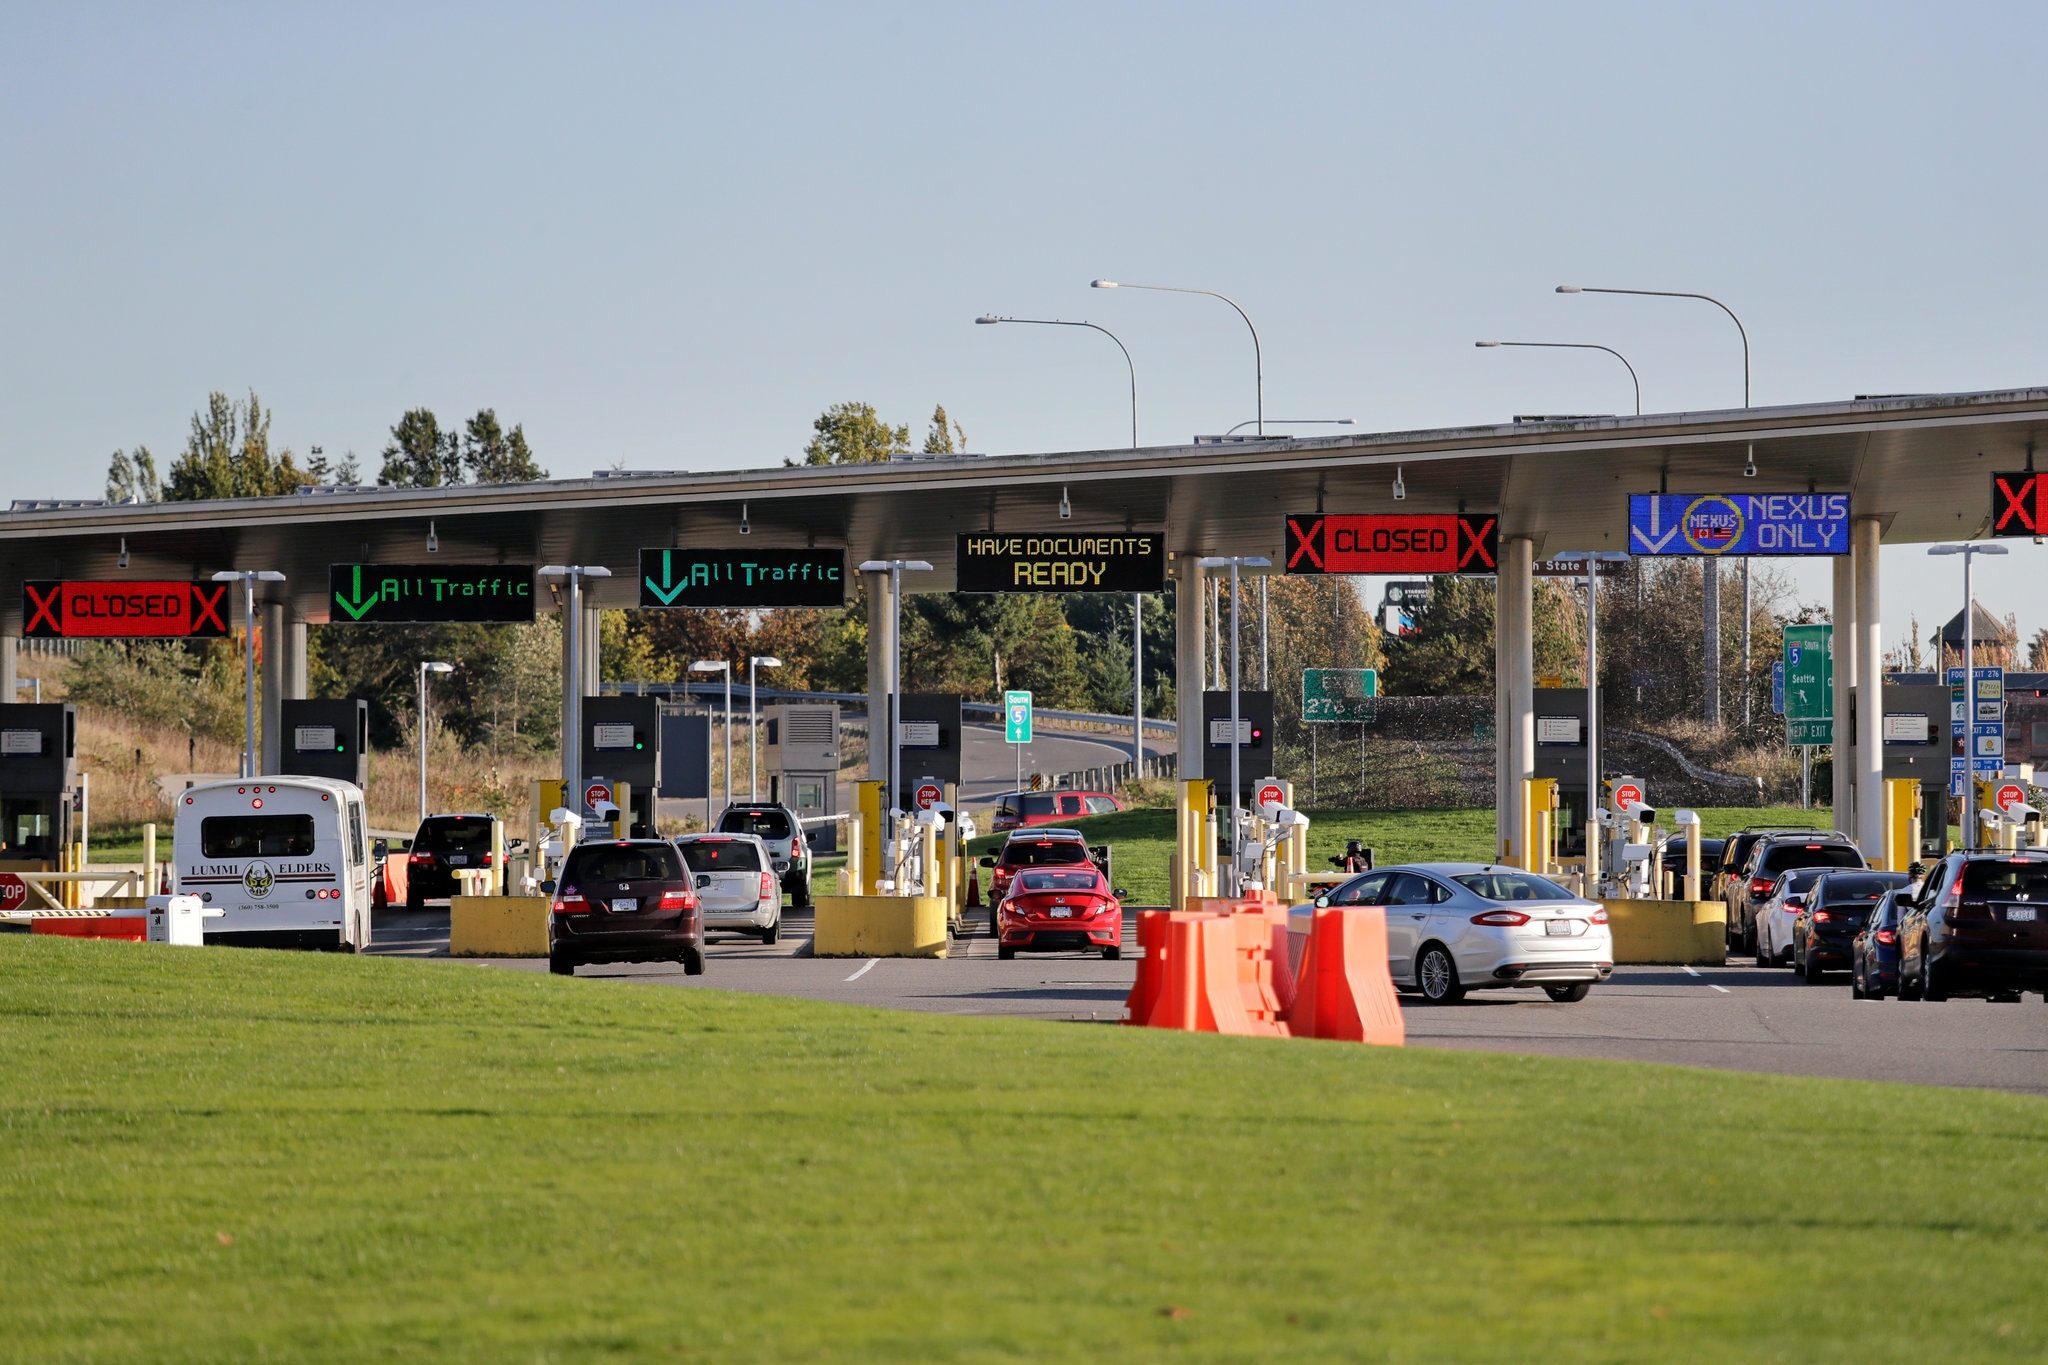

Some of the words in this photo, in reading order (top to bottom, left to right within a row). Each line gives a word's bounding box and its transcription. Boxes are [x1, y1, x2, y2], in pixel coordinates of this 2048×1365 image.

[1749, 496, 1847, 519] NEXUS
[1690, 514, 1737, 528] NEXUS
[1335, 529, 1448, 552] CLOSED
[1758, 523, 1836, 548] ONLY
[968, 538, 1023, 555] HAVE
[1027, 538, 1151, 555] DOCUMENTS
[1546, 561, 1580, 571] State
[691, 563, 733, 586] All
[741, 563, 839, 586] Traffic
[1014, 562, 1106, 585] READY
[381, 579, 423, 601] All
[431, 579, 529, 601] Traffic
[71, 595, 181, 617] CLOSED
[1792, 648, 1798, 665] 5
[1792, 675, 1815, 684] Seattle
[1014, 710, 1023, 723] 5
[1811, 725, 1827, 737] EXIT
[1985, 726, 1998, 734] 276
[591, 790, 606, 798] STOP
[922, 790, 936, 798] STOP
[1622, 790, 1636, 798] STOP
[191, 865, 238, 875] LUMMI
[279, 863, 331, 873] ELDERS
